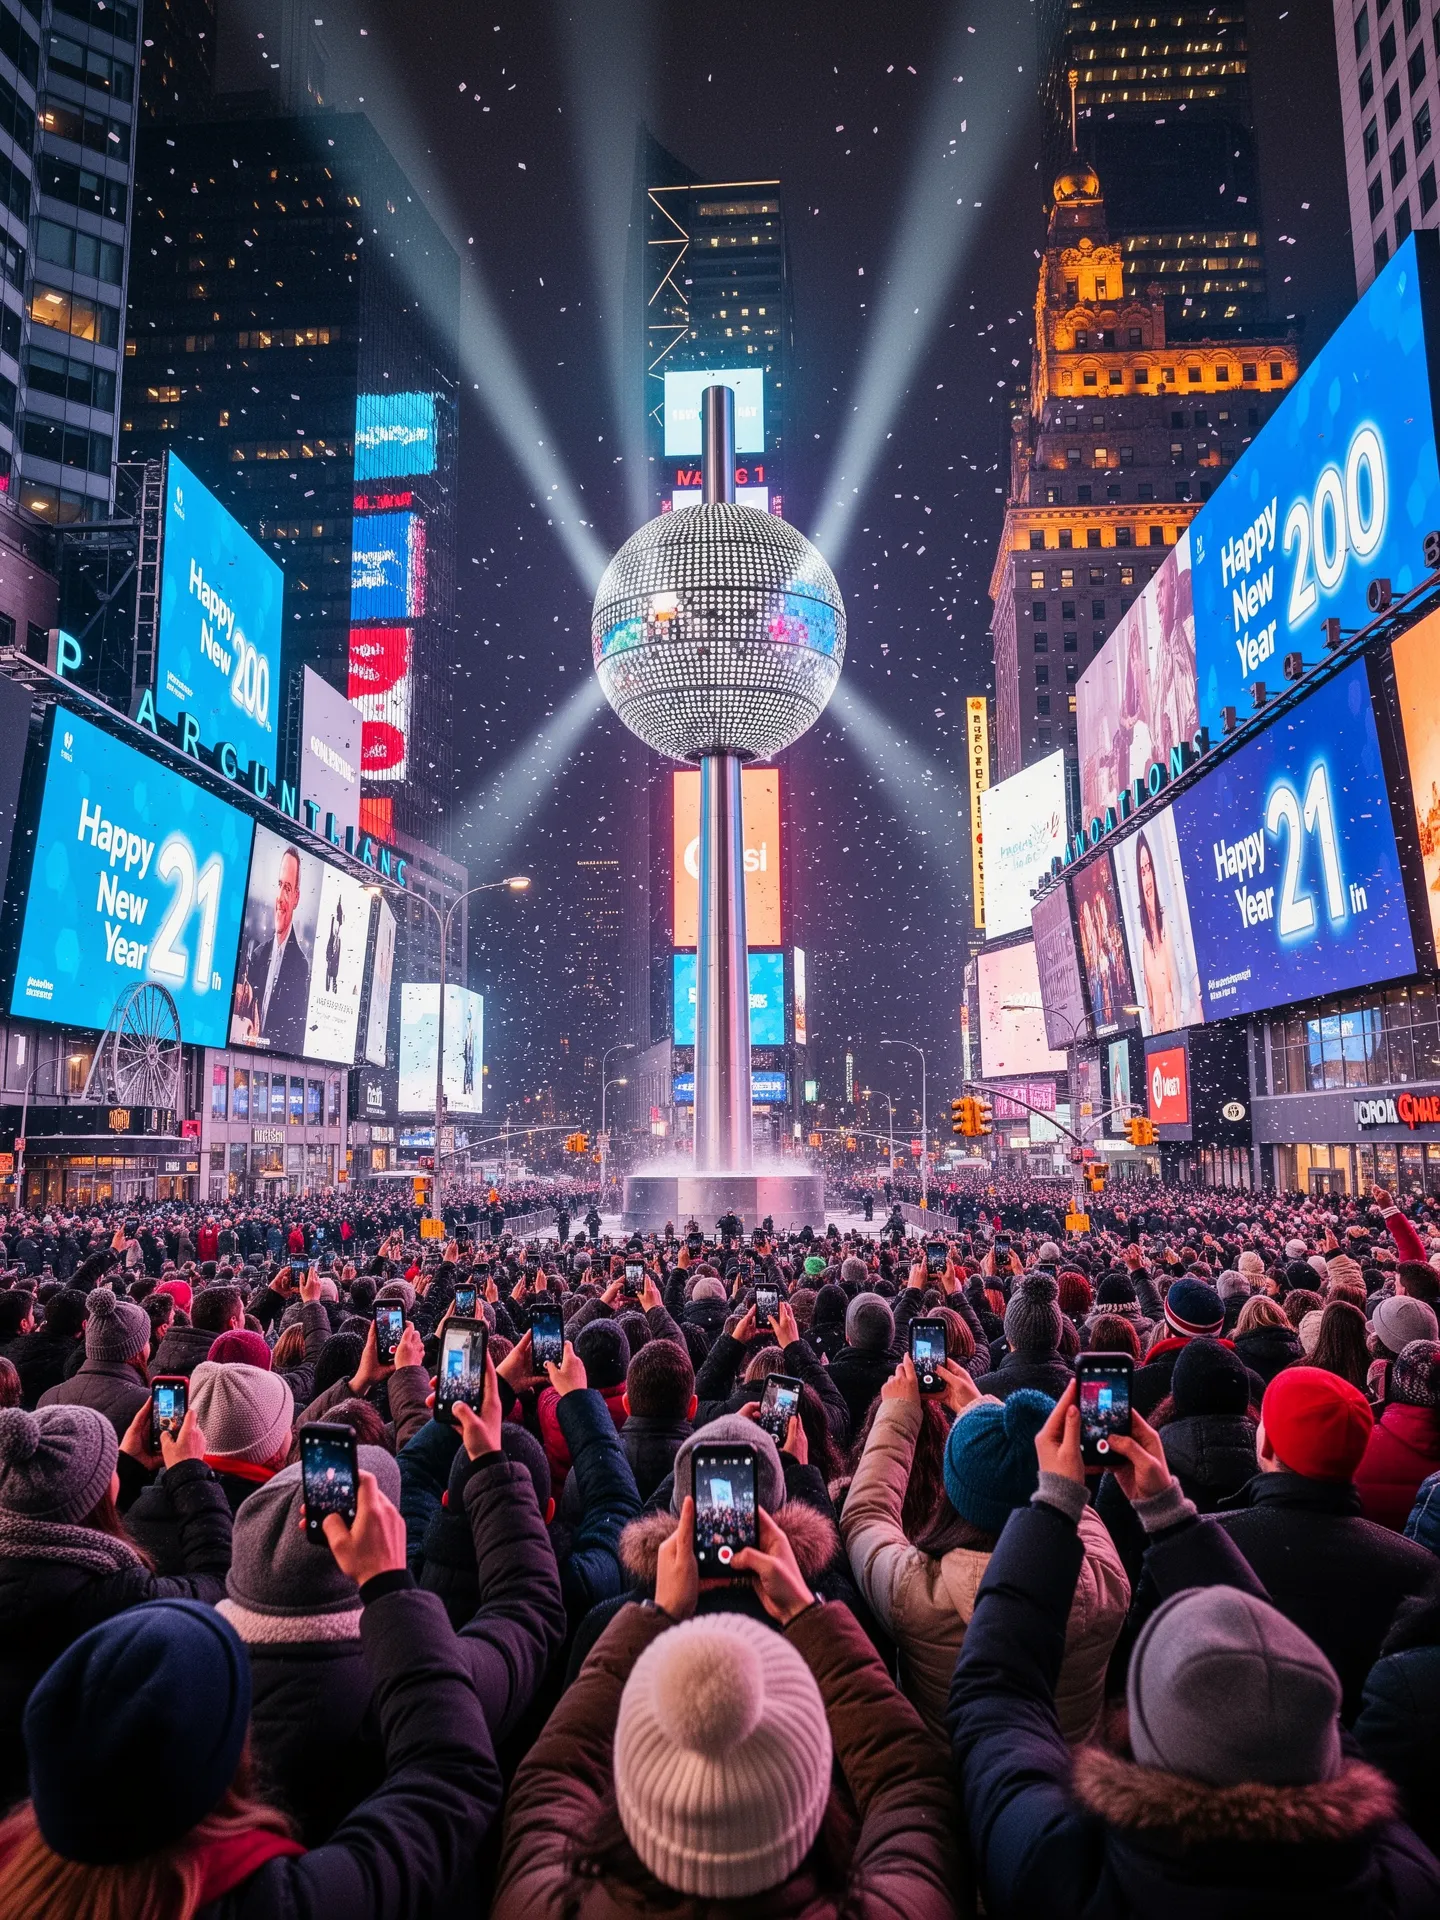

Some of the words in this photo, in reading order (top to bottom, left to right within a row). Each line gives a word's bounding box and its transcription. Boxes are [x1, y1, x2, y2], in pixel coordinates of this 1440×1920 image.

[1220, 496, 1277, 588] Happy
[1284, 428, 1385, 625] 200
[189, 557, 235, 641] Happy
[1232, 565, 1274, 632] New
[200, 618, 231, 676] New
[232, 631, 269, 724] 200
[1235, 619, 1276, 679] Year
[77, 797, 155, 880] Happy
[1213, 828, 1266, 883] Happy
[1267, 763, 1345, 937] 21
[96, 870, 148, 926] New
[149, 841, 222, 984] 21
[1235, 886, 1275, 929] Year
[104, 920, 148, 970] Year
